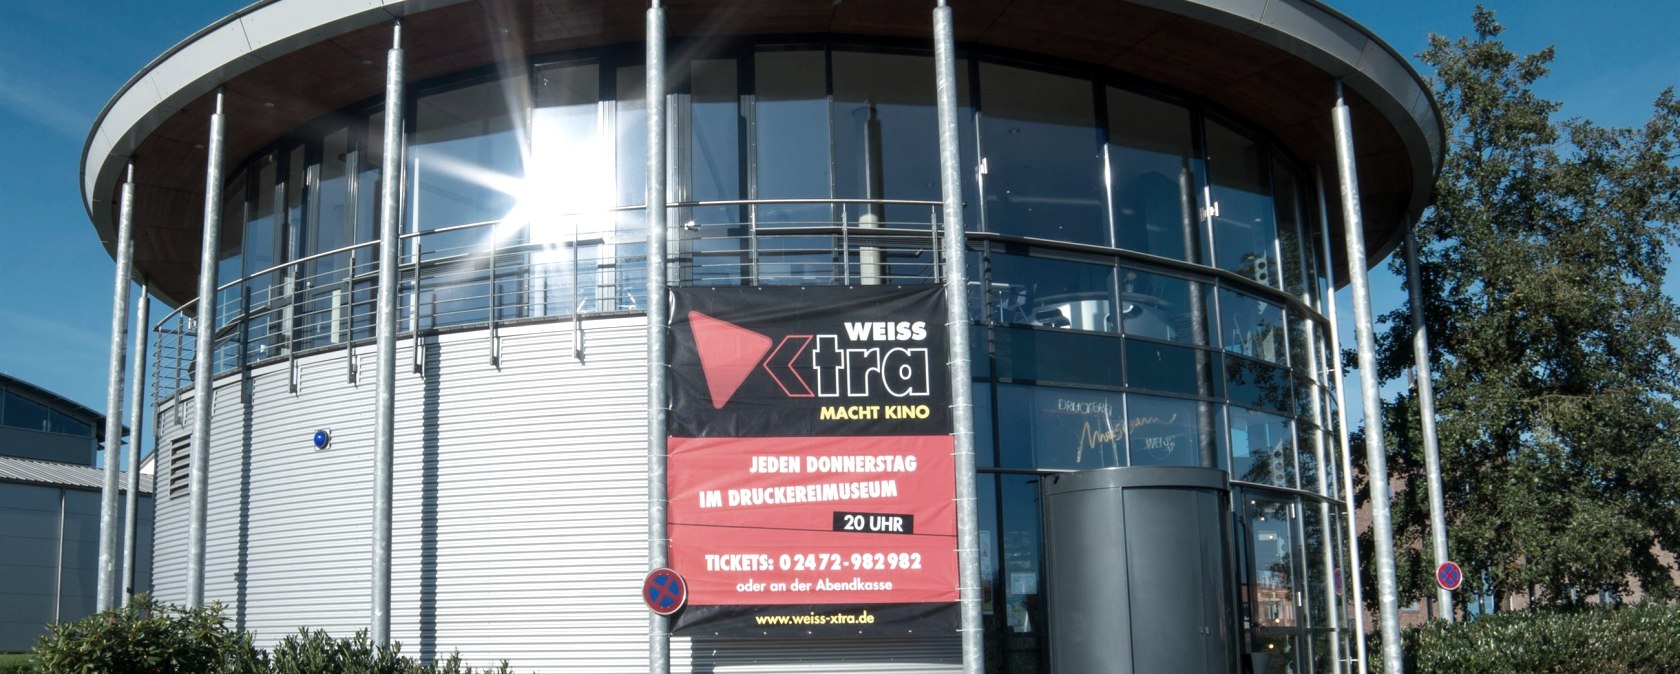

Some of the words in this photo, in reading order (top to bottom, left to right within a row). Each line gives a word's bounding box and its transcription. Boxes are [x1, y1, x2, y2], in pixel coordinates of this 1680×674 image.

[844, 321, 927, 341] WEISS
[820, 405, 880, 420] MACHT
[885, 405, 930, 420] KINO
[749, 455, 801, 474] JEDEN
[806, 455, 917, 473] DONNERSTAG
[699, 490, 723, 508] IM
[728, 480, 898, 507] DRUCKEREIMUSEUM
[844, 514, 865, 531] 20
[870, 515, 903, 532] UHR
[705, 554, 774, 571] TICKETS:
[736, 578, 766, 592] oder
[770, 582, 786, 592] an
[790, 578, 812, 592] der
[816, 577, 893, 592] Abendkasse
[755, 610, 875, 625] www.weiss-xtra.de
